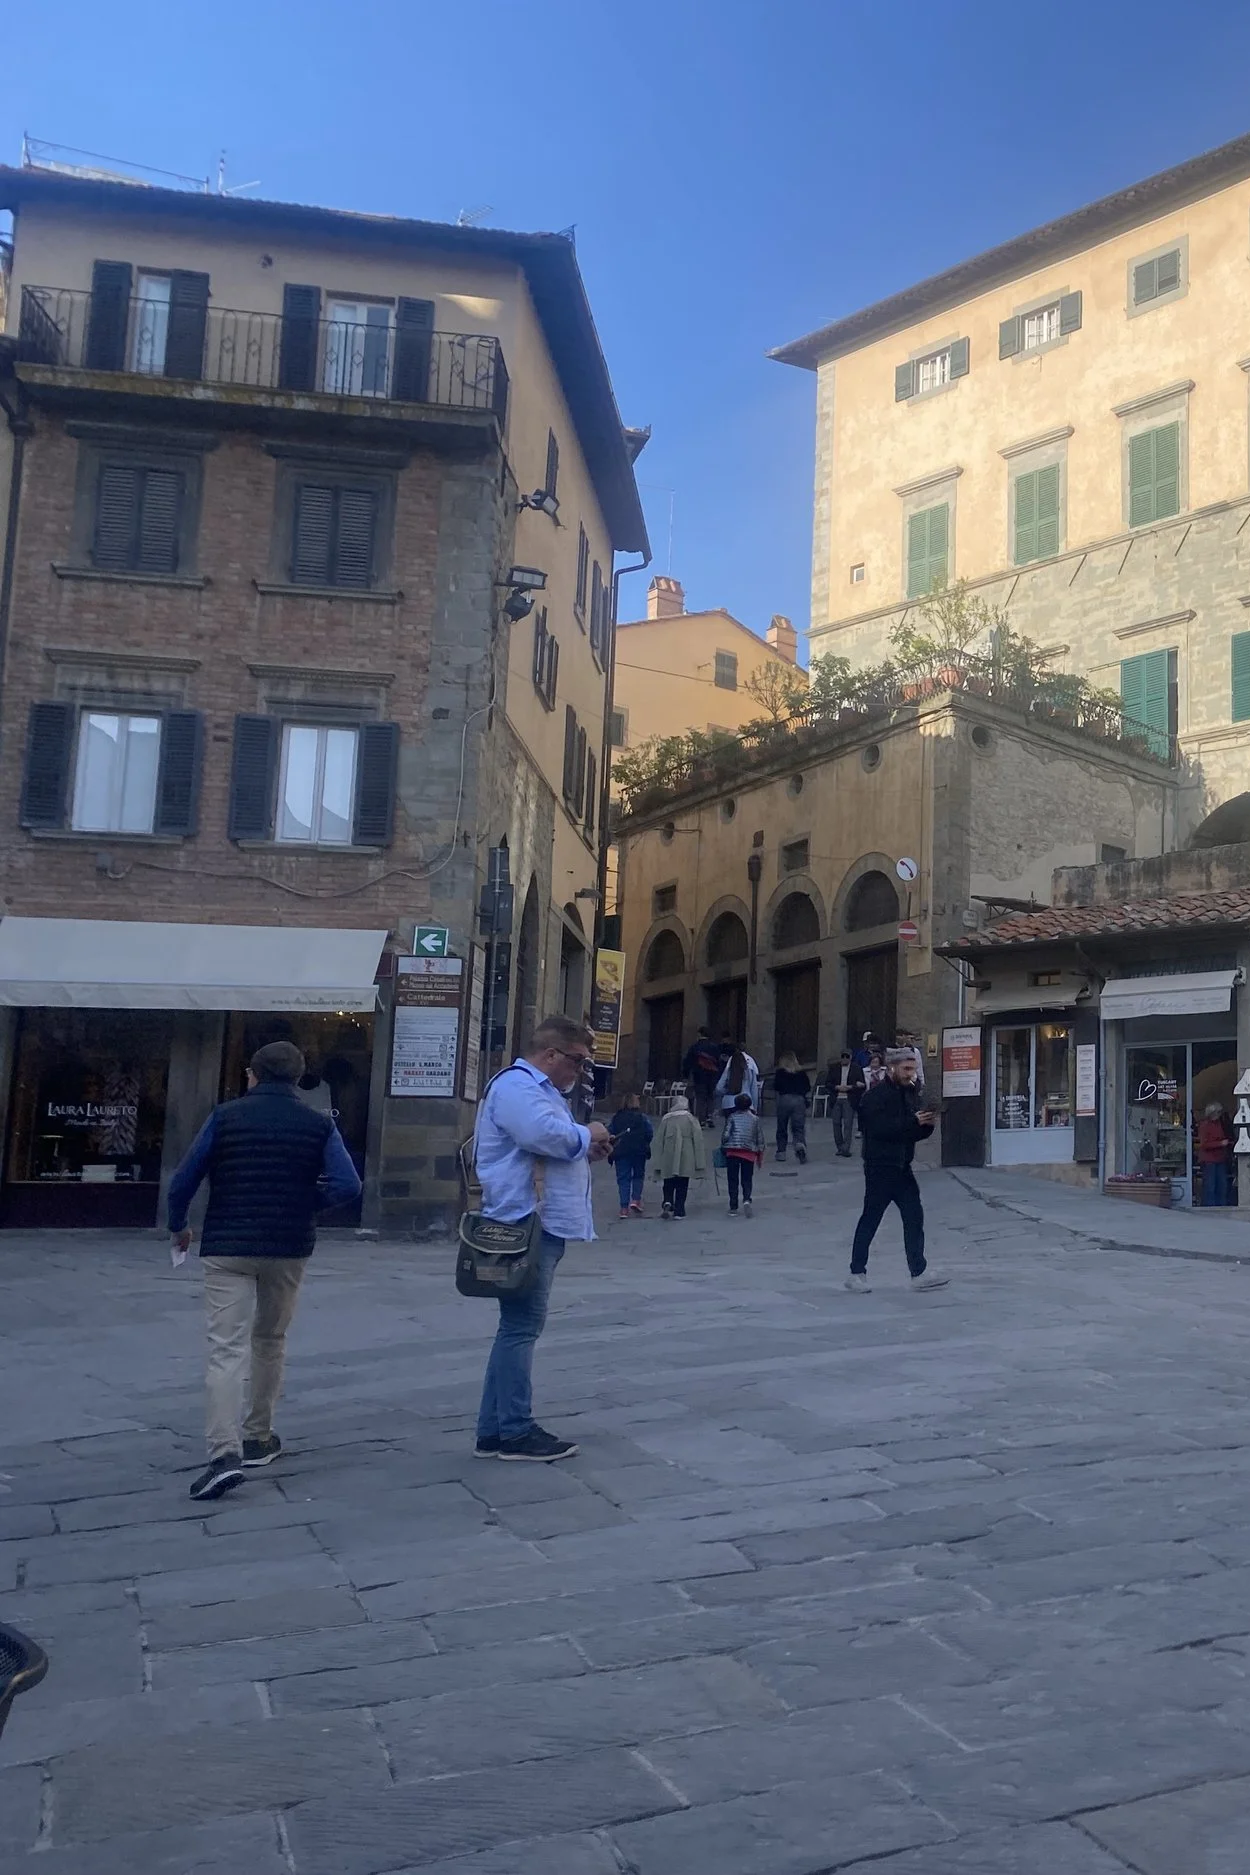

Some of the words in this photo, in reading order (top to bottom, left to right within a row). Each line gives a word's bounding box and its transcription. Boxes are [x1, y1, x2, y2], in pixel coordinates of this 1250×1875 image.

[407, 993, 446, 1001] Cattedrale
[48, 1102, 85, 1116] LAURA
[86, 1103, 138, 1117] LAURETO
